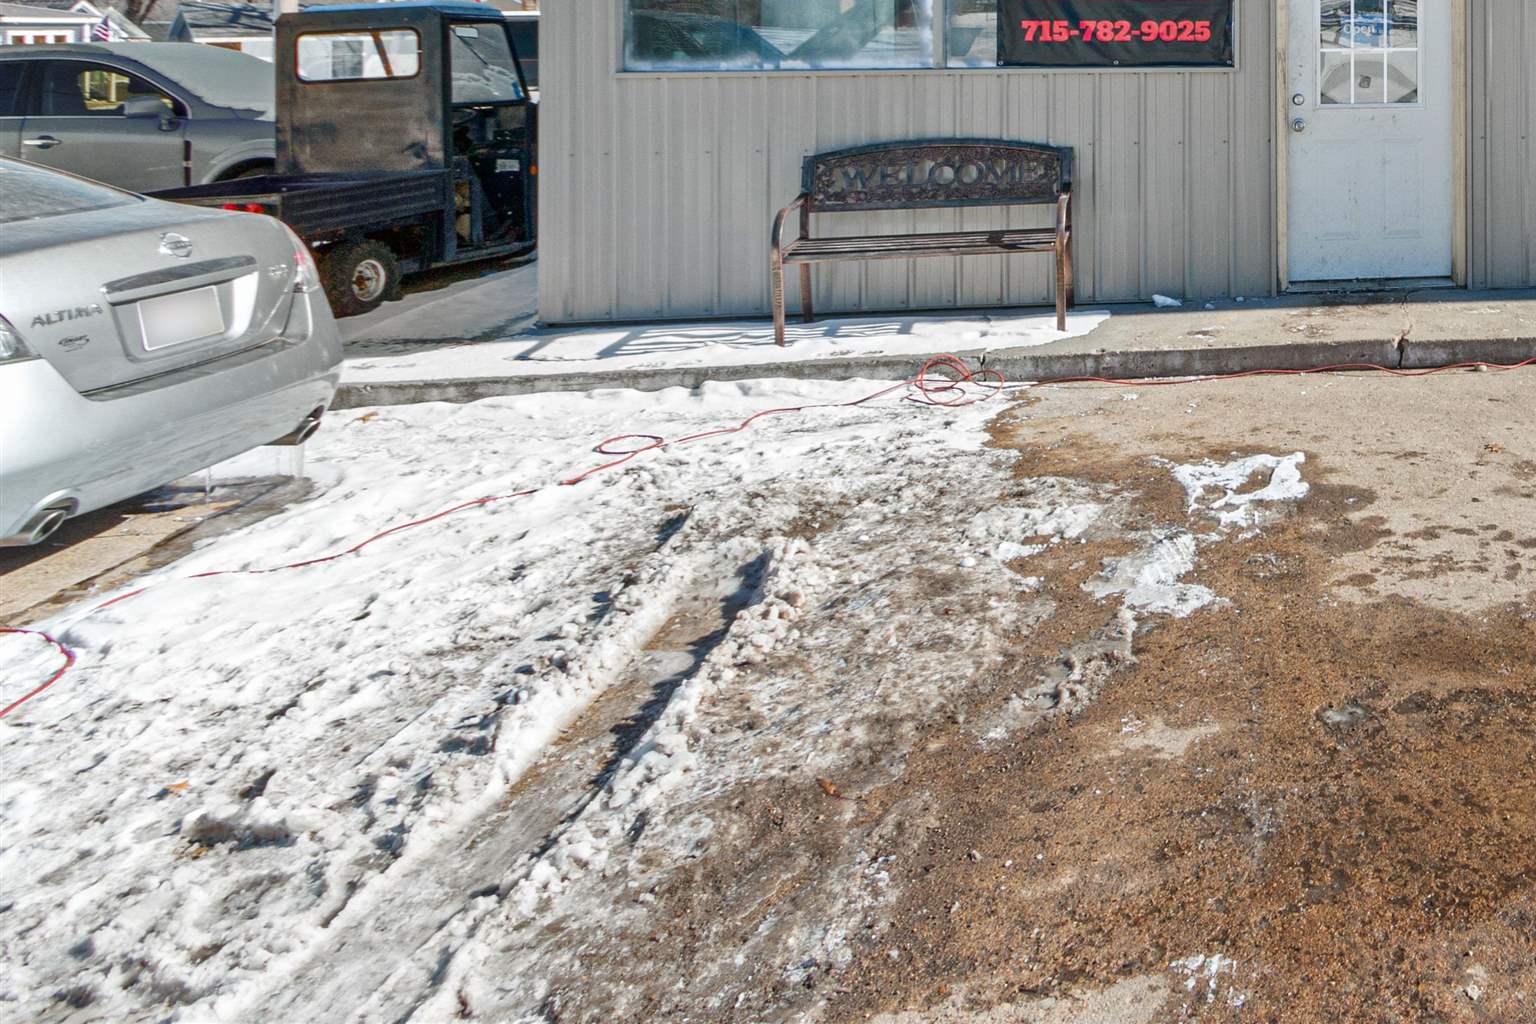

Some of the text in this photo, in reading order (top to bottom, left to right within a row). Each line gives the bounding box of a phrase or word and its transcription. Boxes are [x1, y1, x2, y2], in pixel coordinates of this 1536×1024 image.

[1020, 20, 1211, 43] 715-782-9025
[839, 158, 1042, 190] WELCOME
[30, 303, 103, 328] ALTIMA
